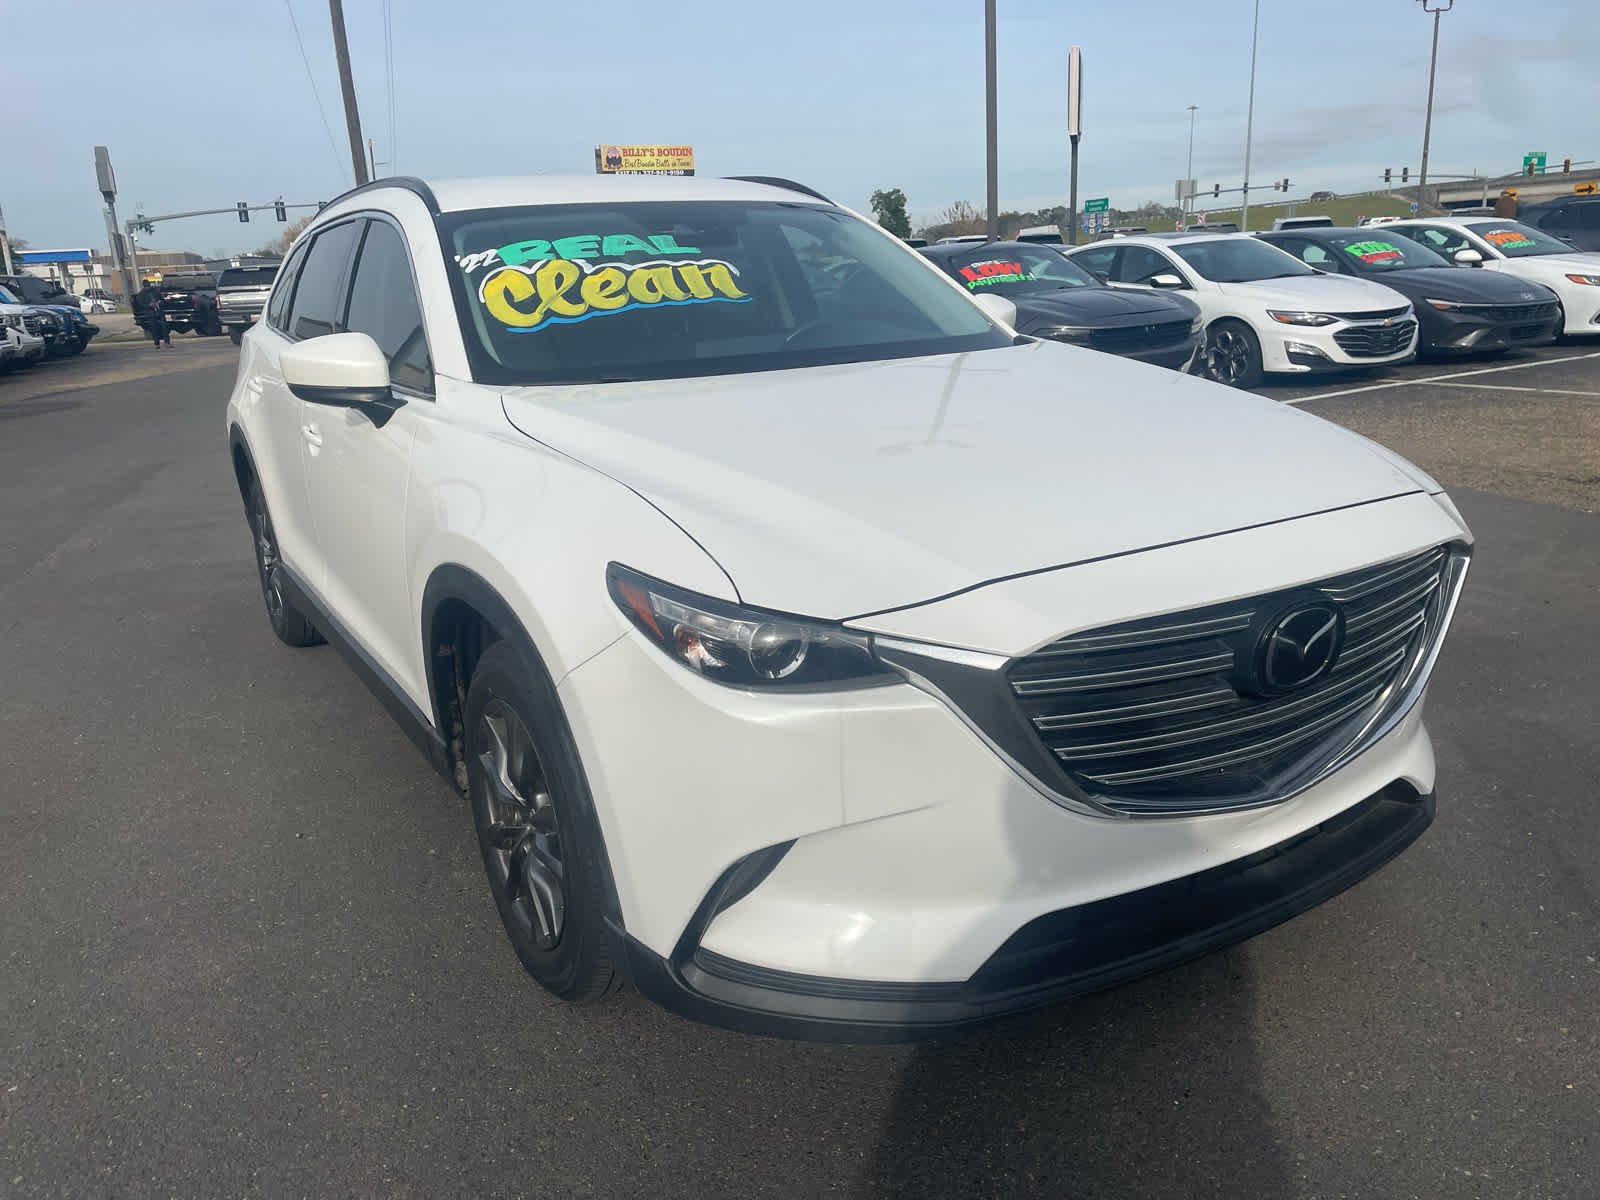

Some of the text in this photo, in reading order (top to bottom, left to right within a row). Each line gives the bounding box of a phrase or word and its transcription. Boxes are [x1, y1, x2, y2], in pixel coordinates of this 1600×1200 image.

[622, 148, 692, 157] BILLY'S BOUDIN
[496, 234, 701, 266] REAL
[960, 262, 1022, 282] LOW
[482, 259, 749, 327] Clean
